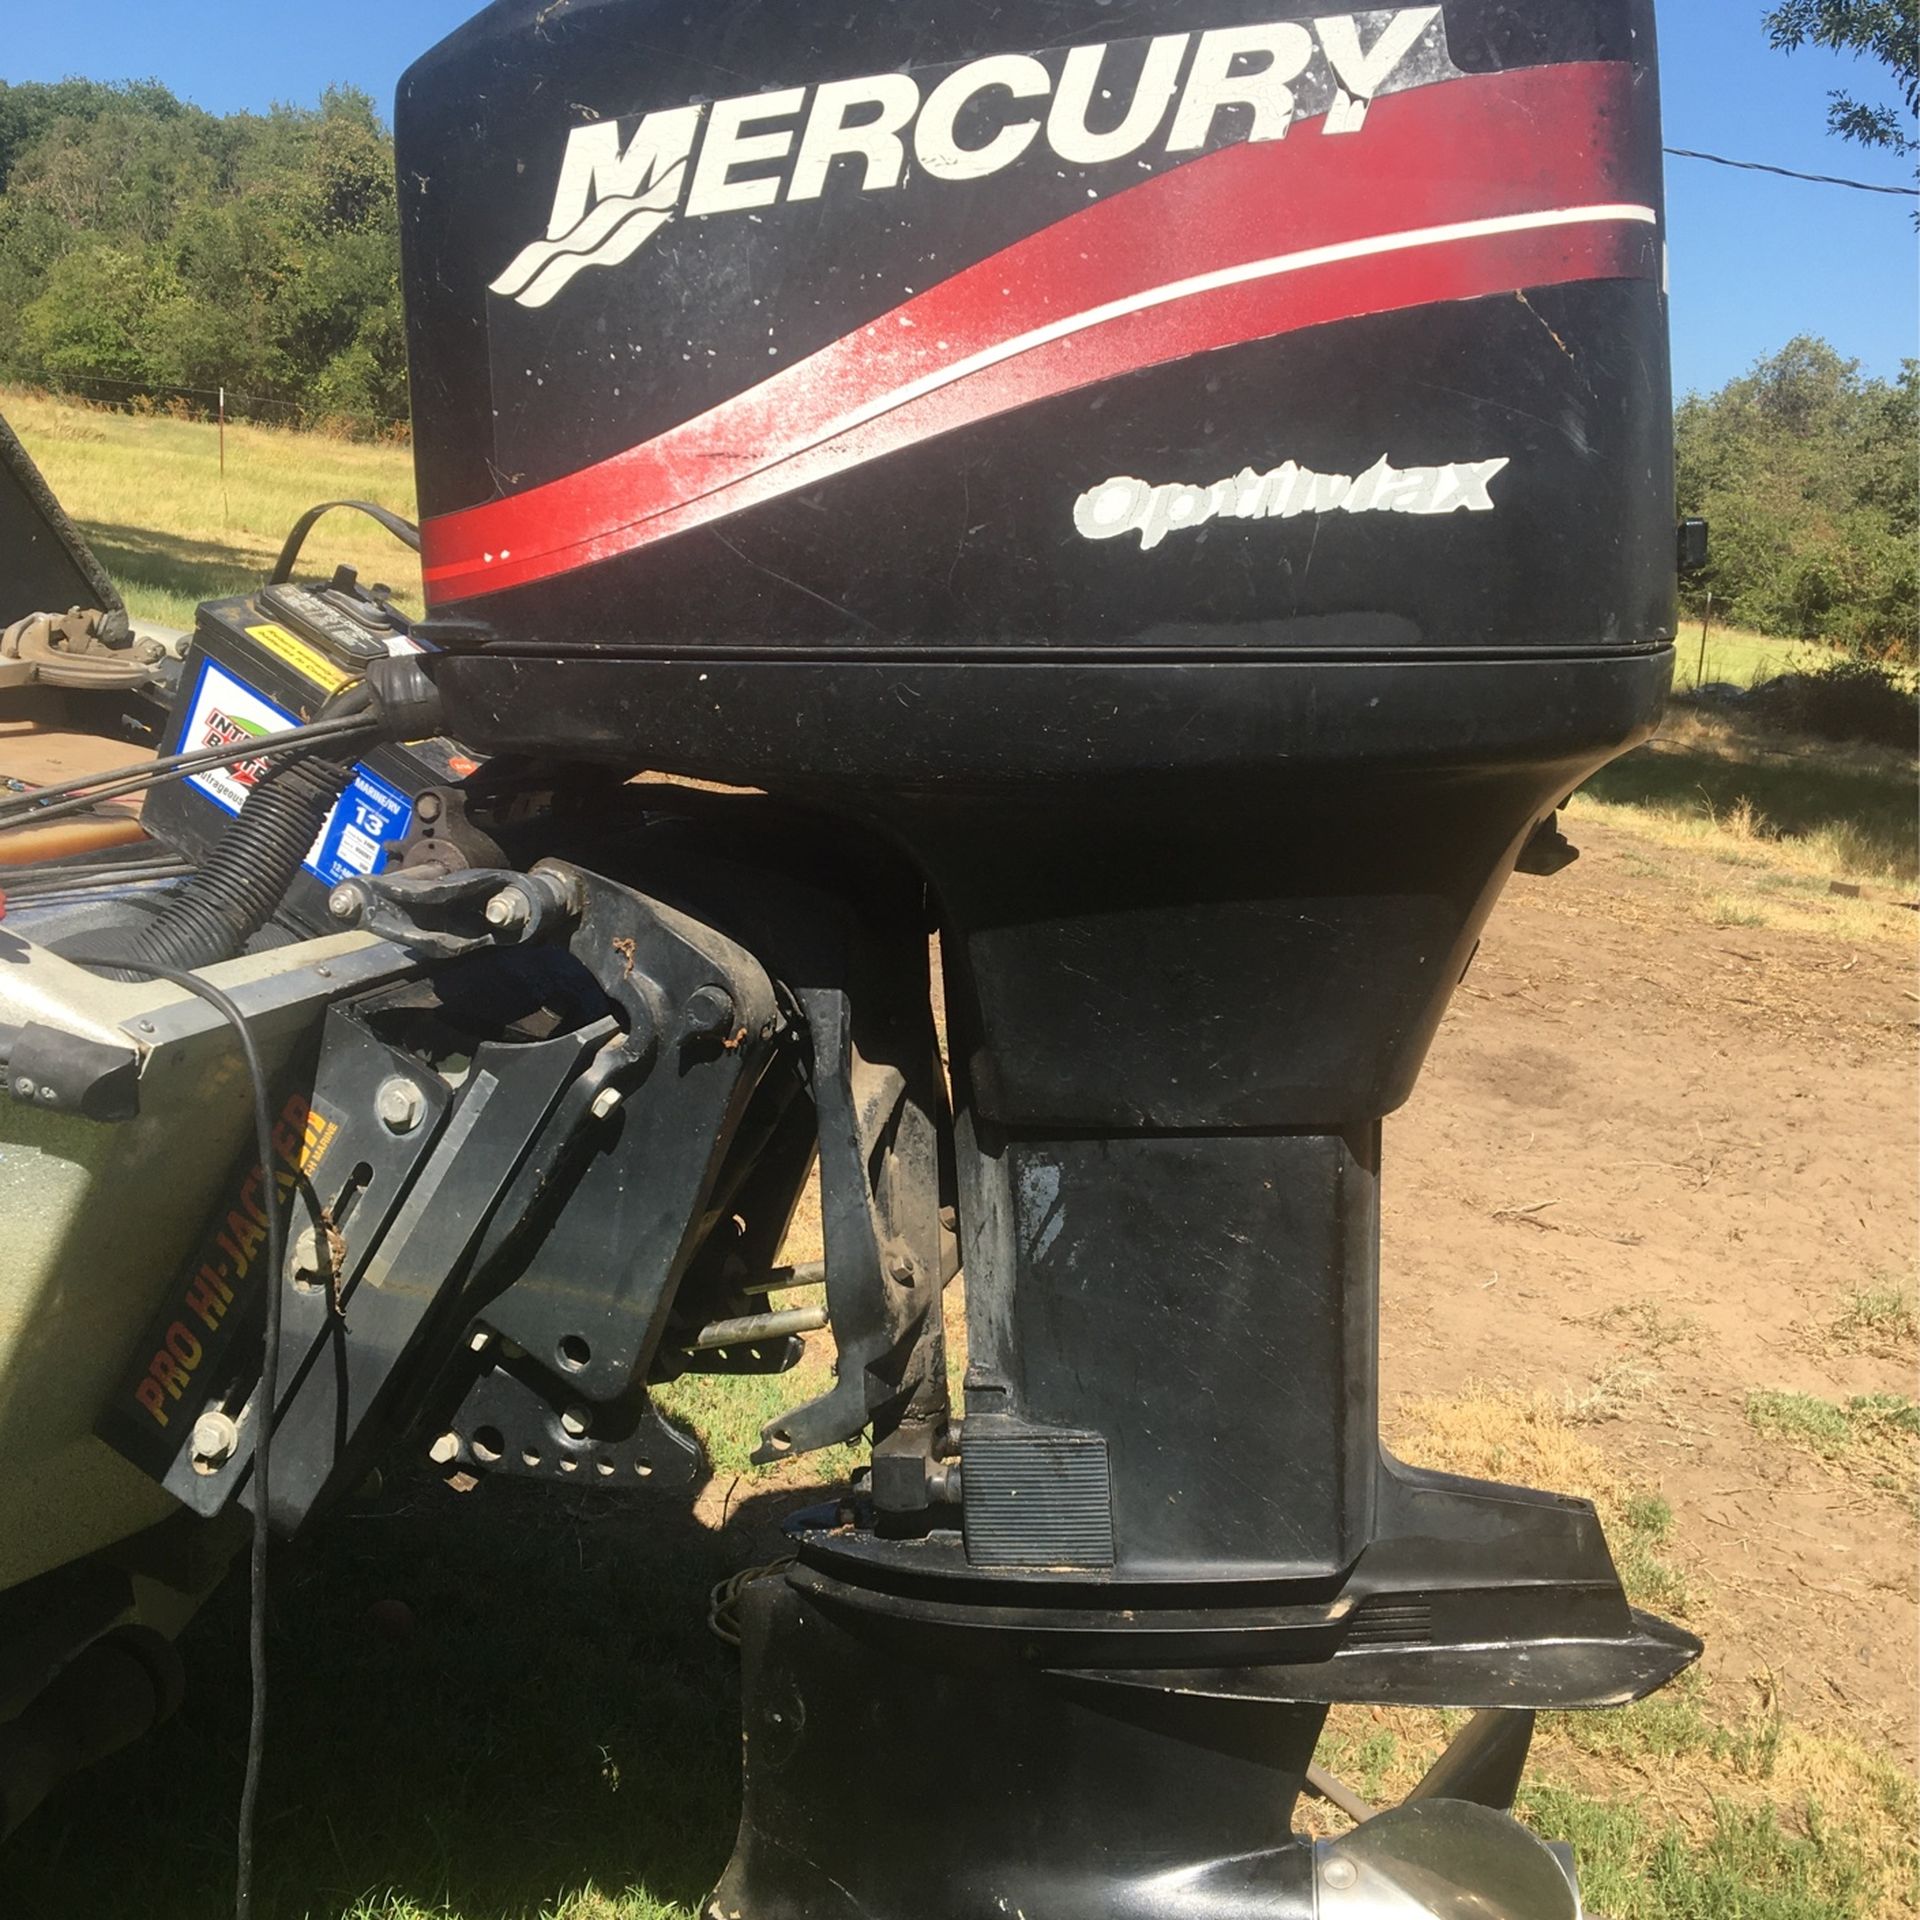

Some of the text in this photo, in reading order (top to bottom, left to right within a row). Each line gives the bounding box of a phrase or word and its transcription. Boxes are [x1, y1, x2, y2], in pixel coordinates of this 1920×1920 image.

[546, 5, 1442, 241] MERCURY
[354, 777, 401, 815] MARINE/RV
[355, 805, 383, 836] 13
[312, 1121, 338, 1162] MARINE
[135, 1320, 203, 1428] PRO
